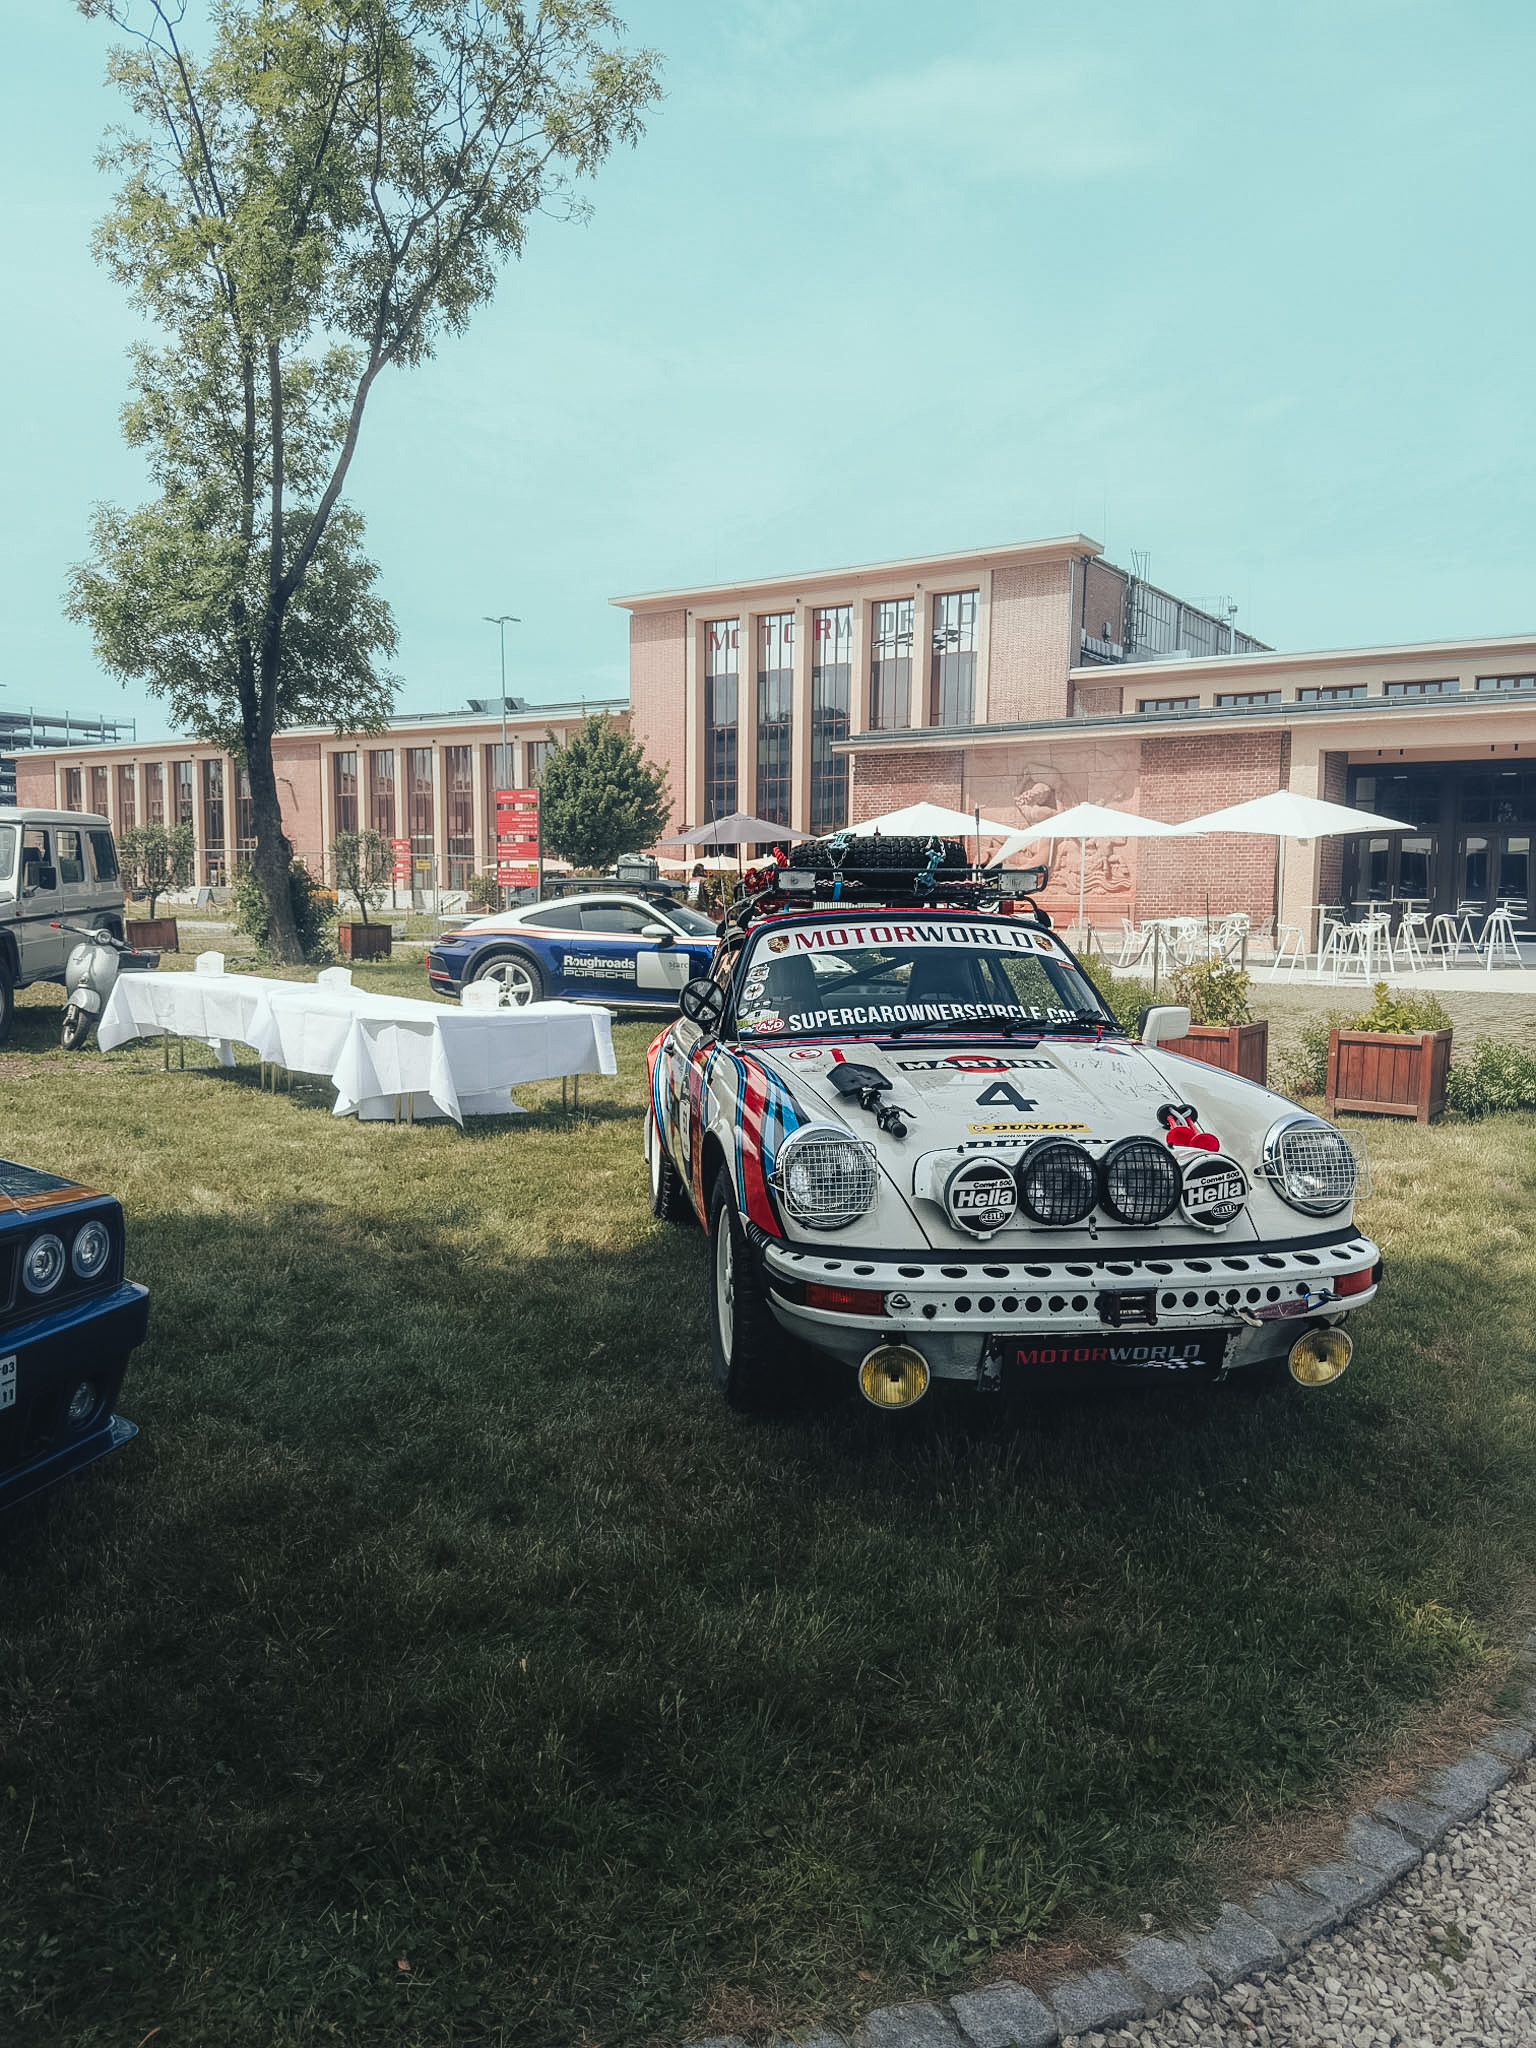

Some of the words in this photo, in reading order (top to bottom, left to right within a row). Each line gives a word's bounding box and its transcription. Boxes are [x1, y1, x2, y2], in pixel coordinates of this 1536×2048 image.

[795, 926, 1033, 949] MOTORWORLD
[563, 955, 636, 969] Roughroads
[563, 970, 636, 980] PORSCHE
[759, 1021, 783, 1031] AvD
[903, 1060, 1049, 1070] MARTINI
[976, 1082, 1040, 1111] 4
[973, 1181, 998, 1189] Comet
[1200, 1173, 1225, 1185] Comet
[1226, 1171, 1240, 1179] 500
[957, 1188, 1014, 1207] Hella
[1187, 1181, 1242, 1206] Hella
[1016, 1344, 1201, 1366] MOTORWORLD
[2, 1361, 15, 1376] 03
[3, 1389, 14, 1403] 11
